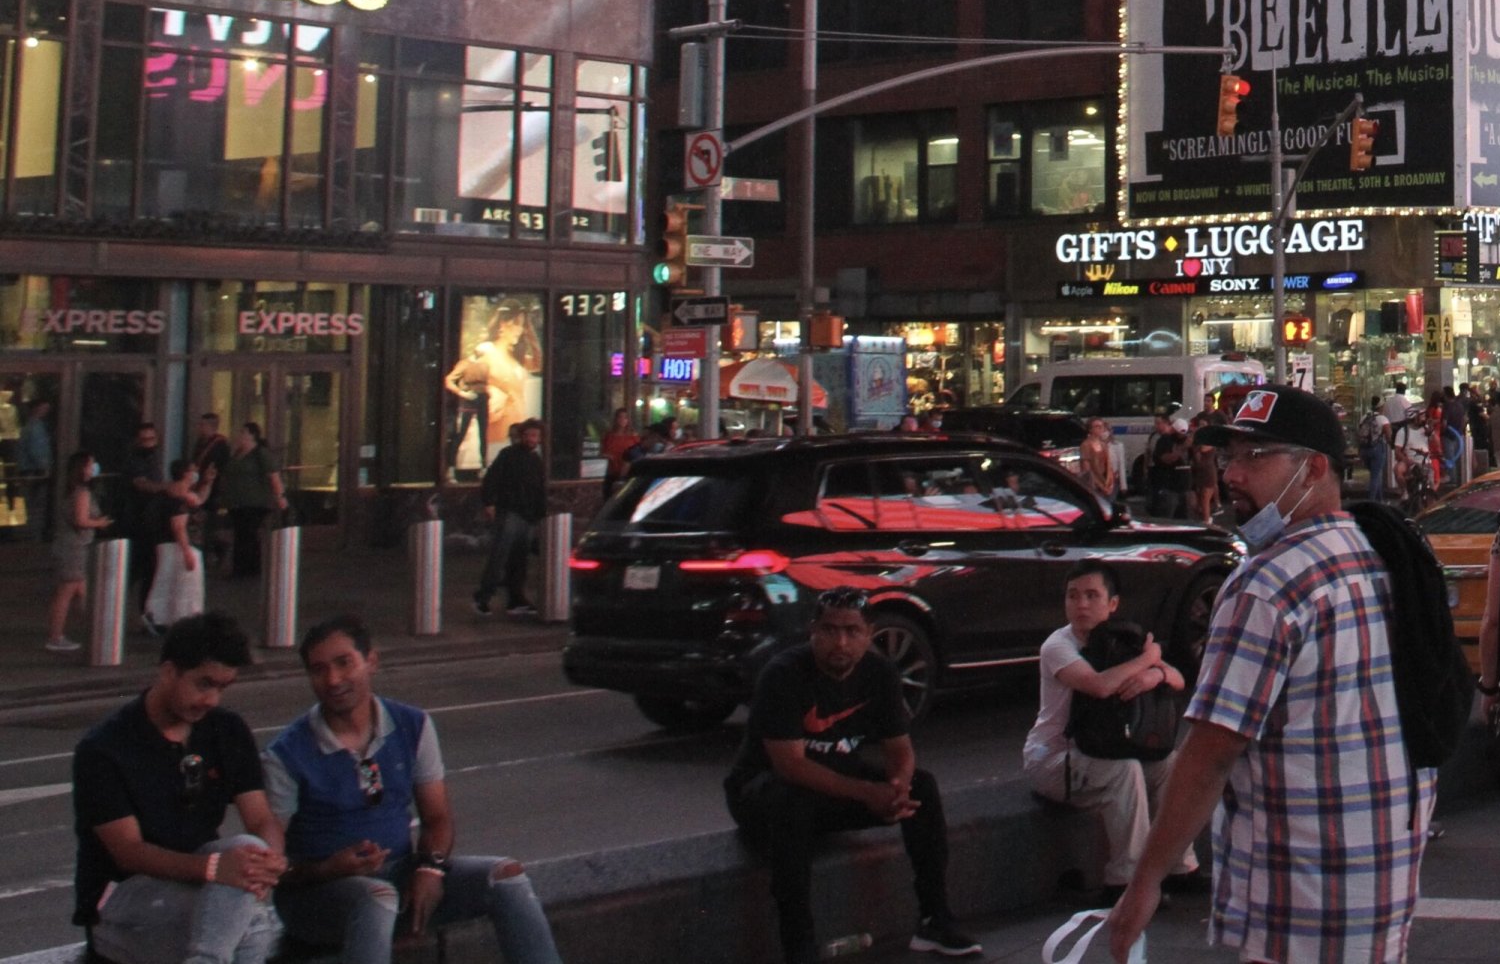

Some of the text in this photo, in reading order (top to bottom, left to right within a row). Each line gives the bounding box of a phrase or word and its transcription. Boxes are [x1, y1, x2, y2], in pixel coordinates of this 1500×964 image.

[1277, 63, 1453, 94] The Musical. The Musical.
[1469, 66, 1487, 84] The
[1284, 125, 1329, 150] GOOD
[1136, 191, 1157, 204] NOW
[1158, 190, 1171, 202] ON
[1173, 187, 1219, 201] BROADWAY
[1243, 183, 1273, 196] WINTE
[1316, 177, 1355, 192] THEATRE,
[1358, 175, 1381, 189] 50TH
[1384, 174, 1391, 187] &
[1393, 171, 1446, 187] BROADWAY
[723, 245, 743, 257] WAY
[1055, 219, 1364, 263] GIFTS LUGGAGE
[1201, 258, 1231, 276] NY
[1071, 276, 1353, 297] Apple Nikon Canon SONY WER SAMSUNG
[22, 309, 365, 335] EXPRESS EXPRESS
[1301, 322, 1309, 340] 2
[1443, 316, 1451, 351] ATM
[1426, 317, 1437, 351] ATM
[664, 358, 693, 379] HOT
[1296, 368, 1307, 389] 7
